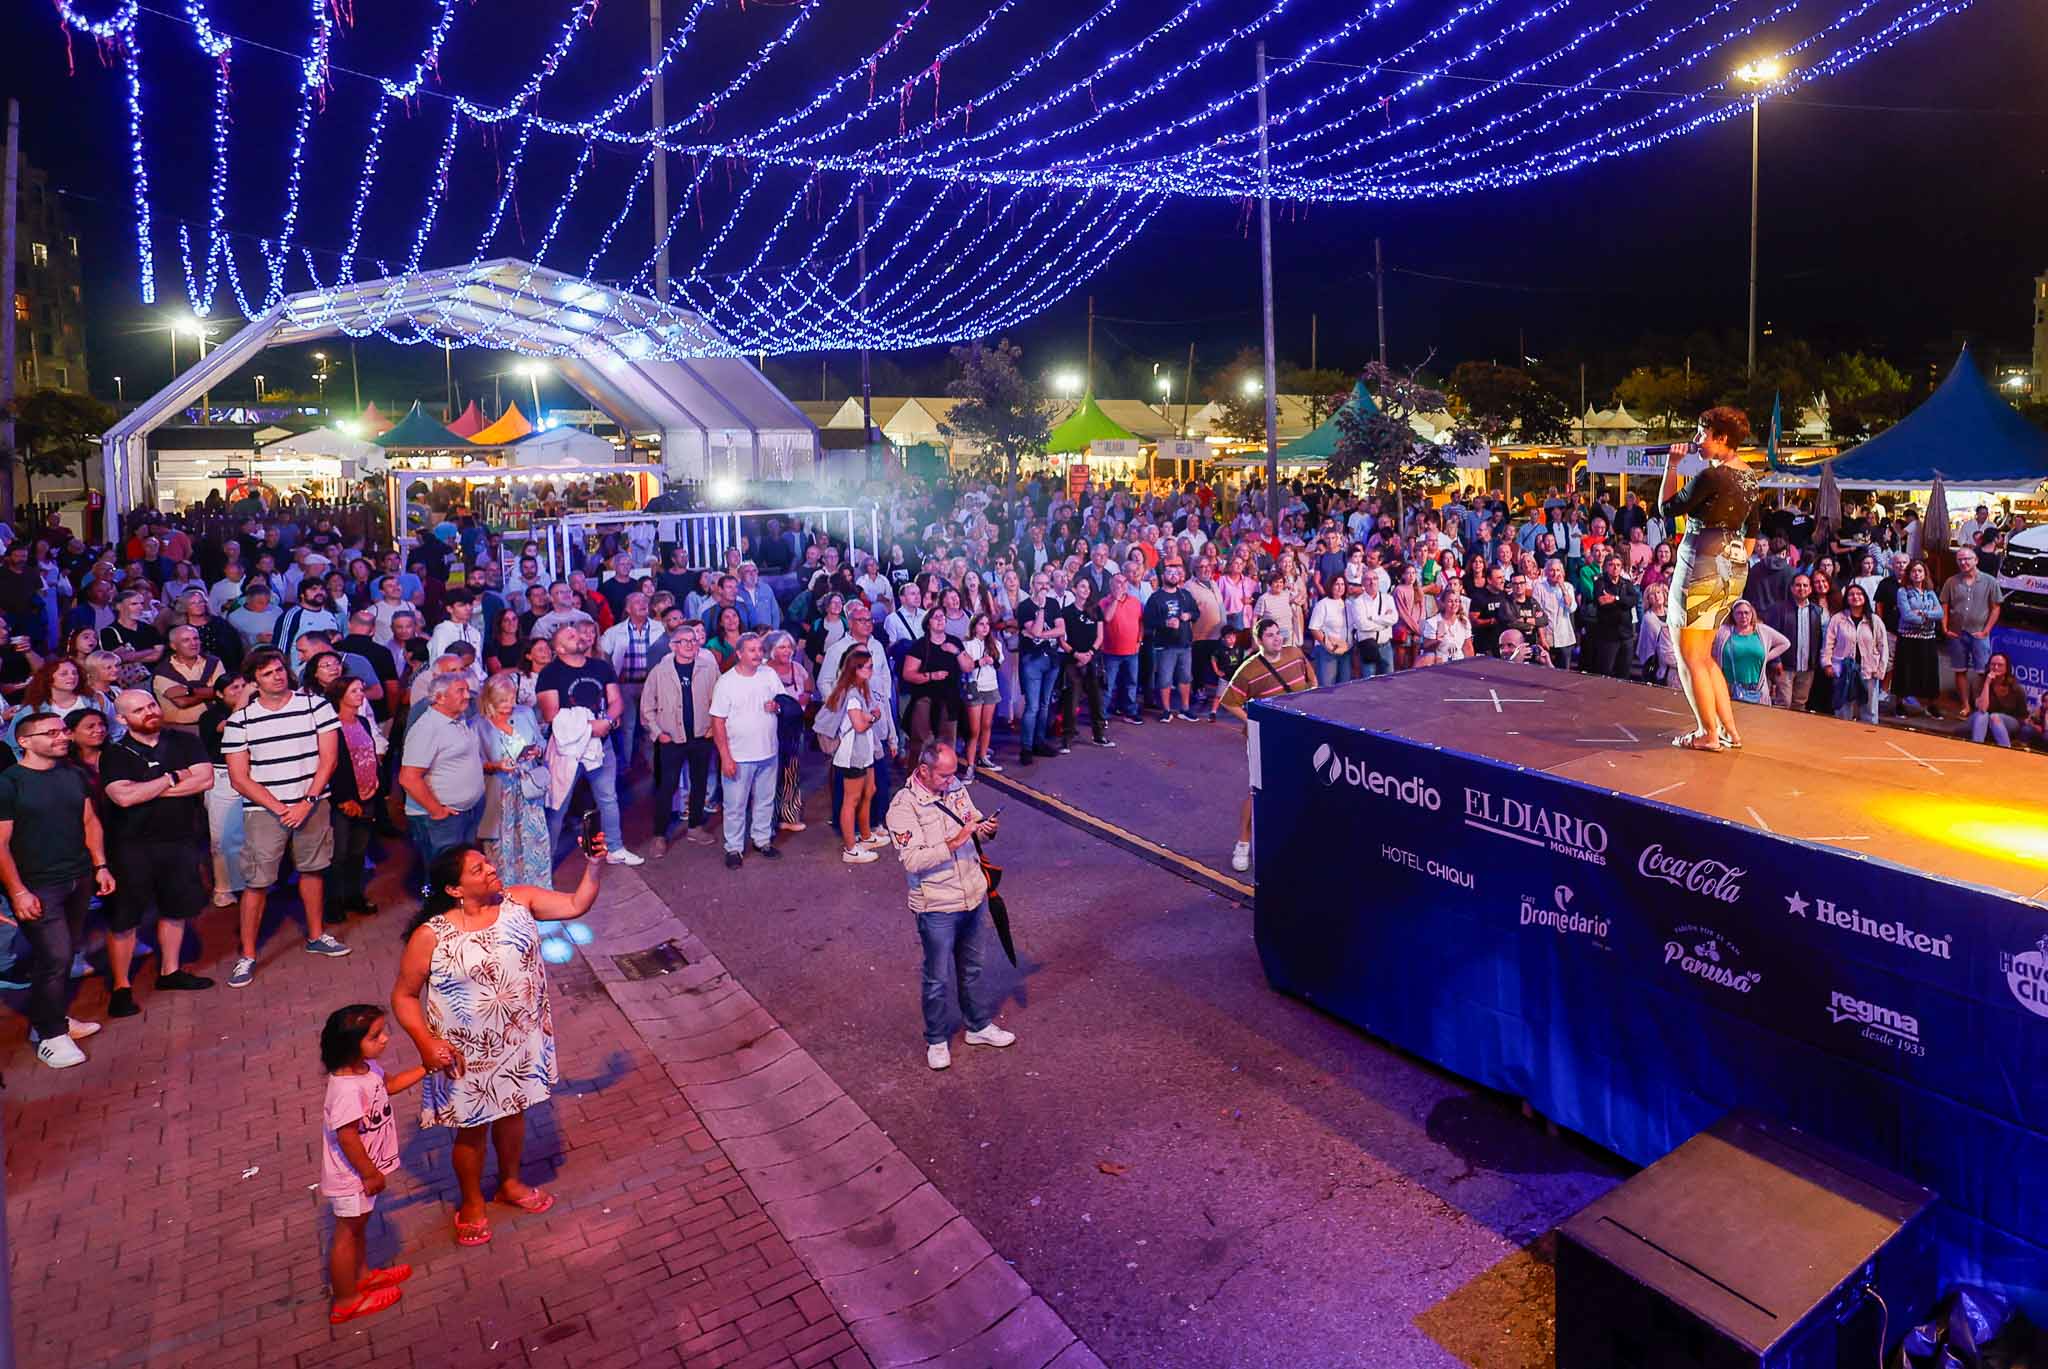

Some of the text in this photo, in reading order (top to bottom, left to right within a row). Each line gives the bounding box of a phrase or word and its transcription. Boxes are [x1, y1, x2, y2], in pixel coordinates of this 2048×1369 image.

[1627, 450, 1668, 466] BRASIL
[2011, 664, 2048, 686] OBL
[1345, 756, 1441, 811] blendio
[1464, 787, 1608, 853] EL DIARIO
[1382, 843, 1474, 889] HOTEL CHIQUI
[1550, 840, 1607, 866] MONTAÑÉS
[1638, 844, 1748, 904] Coca-Cola
[1520, 902, 1608, 937] Dromedario
[1816, 898, 1951, 960] Heineken
[1664, 941, 1752, 993] Panusa
[1832, 990, 1919, 1035] regma
[1861, 1026, 1926, 1057] desde 1933
